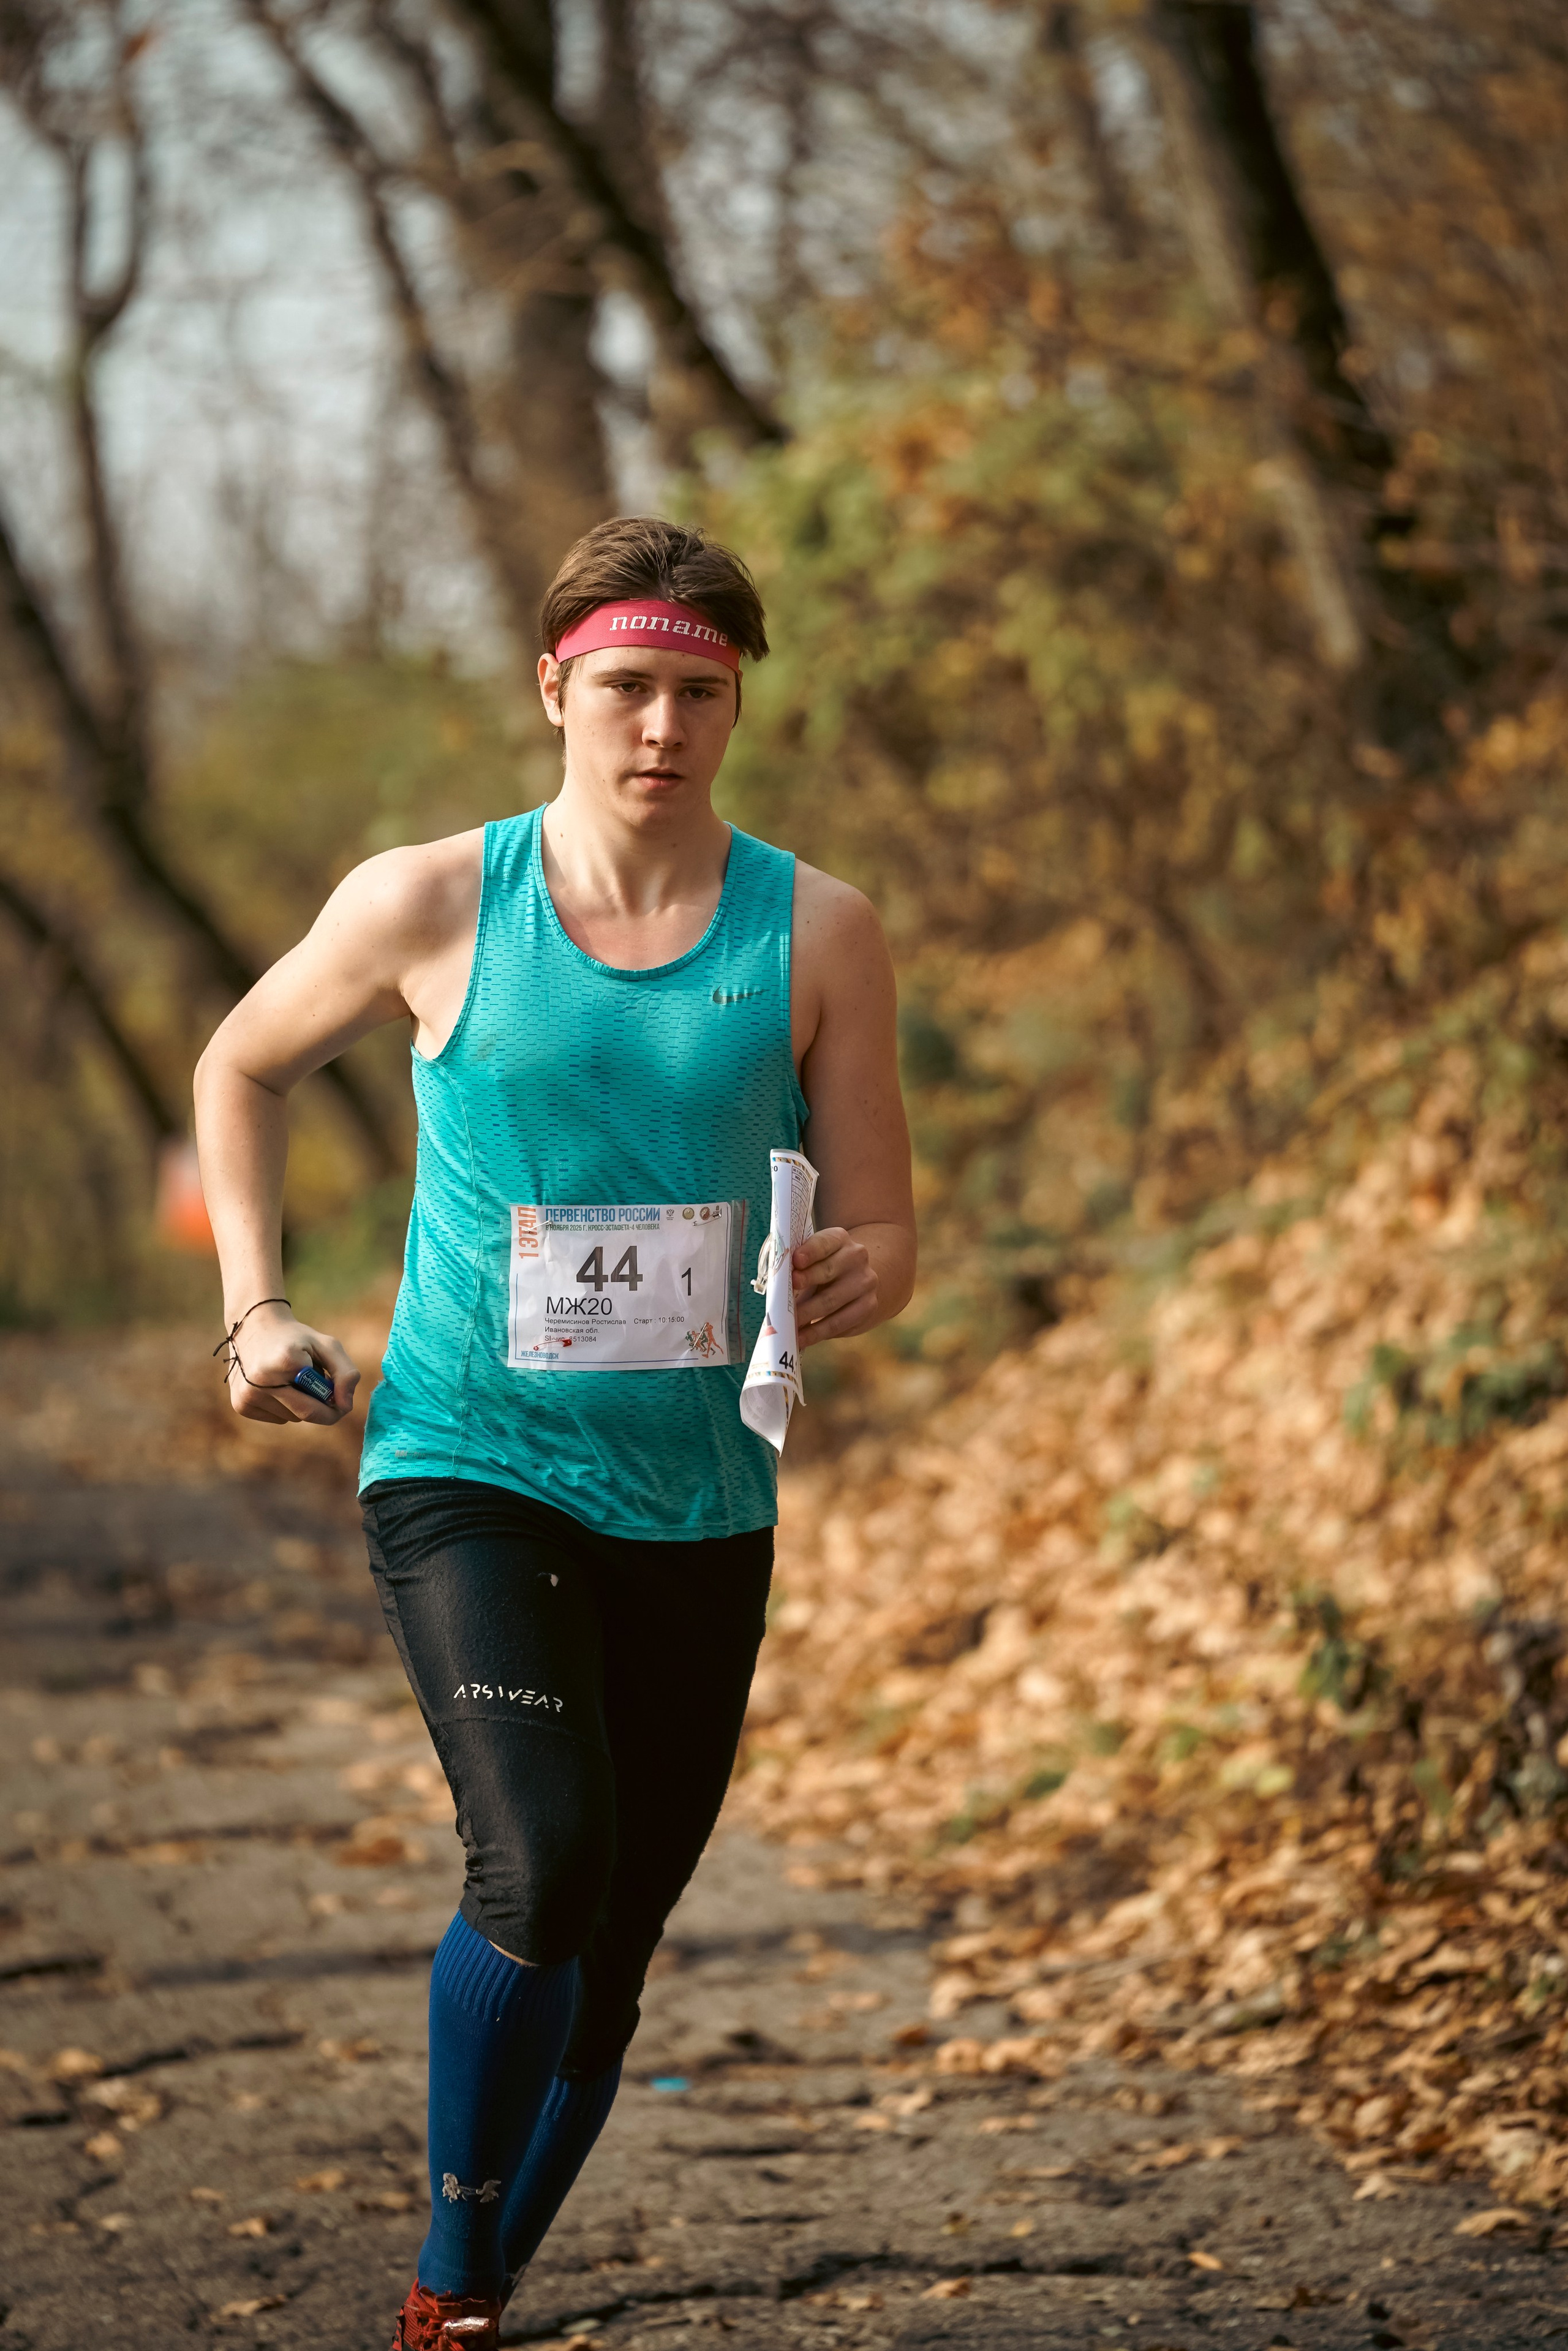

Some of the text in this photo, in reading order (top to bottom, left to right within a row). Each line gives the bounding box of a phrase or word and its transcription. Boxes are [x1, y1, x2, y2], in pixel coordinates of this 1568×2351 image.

[609, 615, 728, 647] noname
[518, 1207, 538, 1248] ЭТАП
[546, 1207, 660, 1222] ПЕРВЕНСТВО РОССИИ
[576, 1245, 643, 1292] 44
[681, 1267, 692, 1296] 1
[546, 1296, 612, 1316] МЖ20
[521, 1350, 559, 1359] ЖЕЛЕЗНОВОДСК
